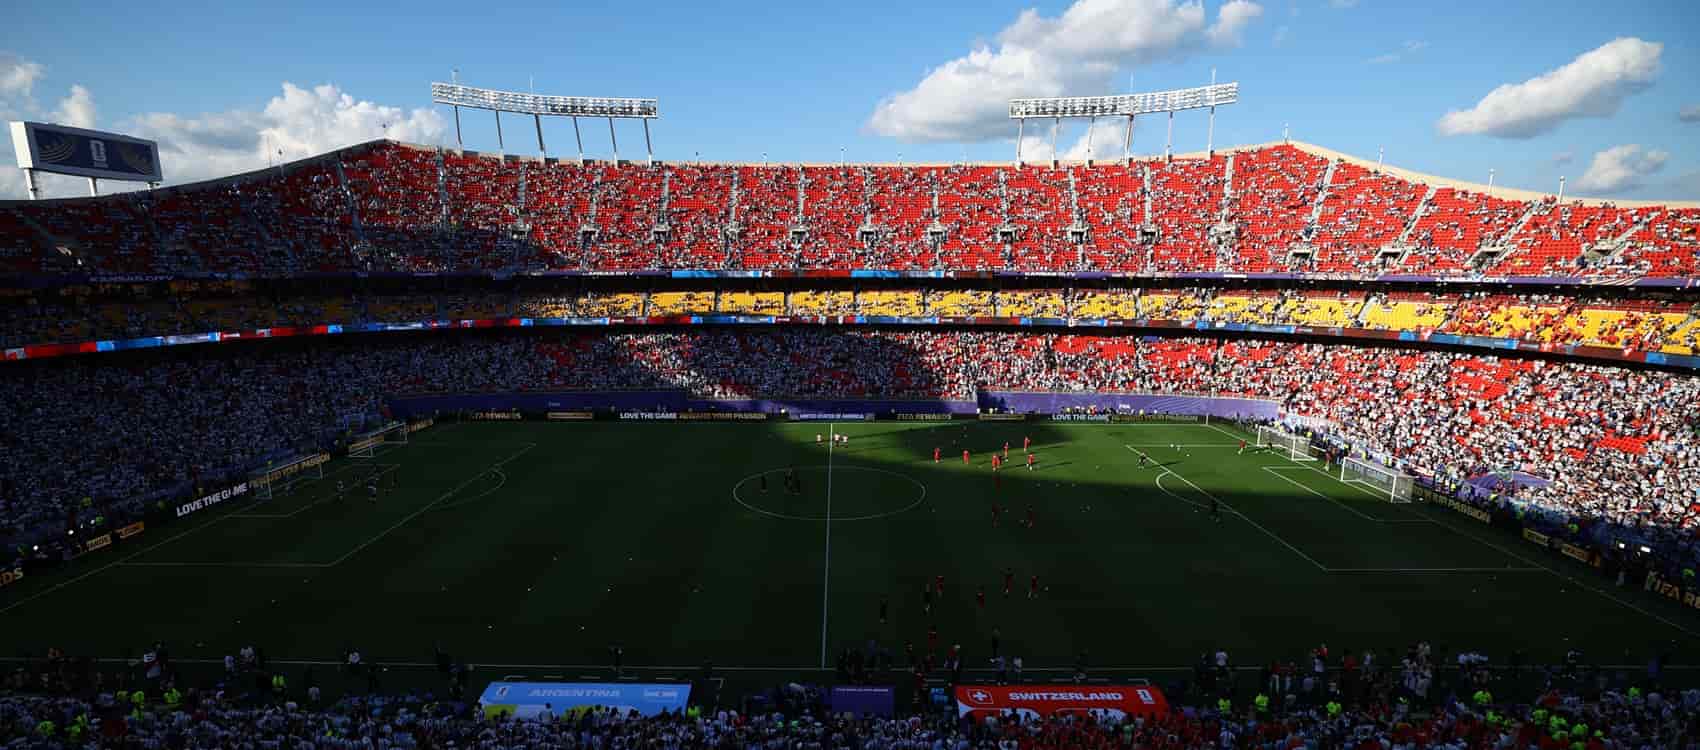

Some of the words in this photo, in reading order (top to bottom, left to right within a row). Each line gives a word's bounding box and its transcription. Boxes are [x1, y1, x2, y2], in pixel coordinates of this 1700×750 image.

[620, 412, 639, 420] LOVE
[176, 498, 203, 517] LOVE
[204, 491, 223, 507] THE
[528, 687, 622, 697] ARGENTINA
[1008, 691, 1124, 701] SWITZERLAND
